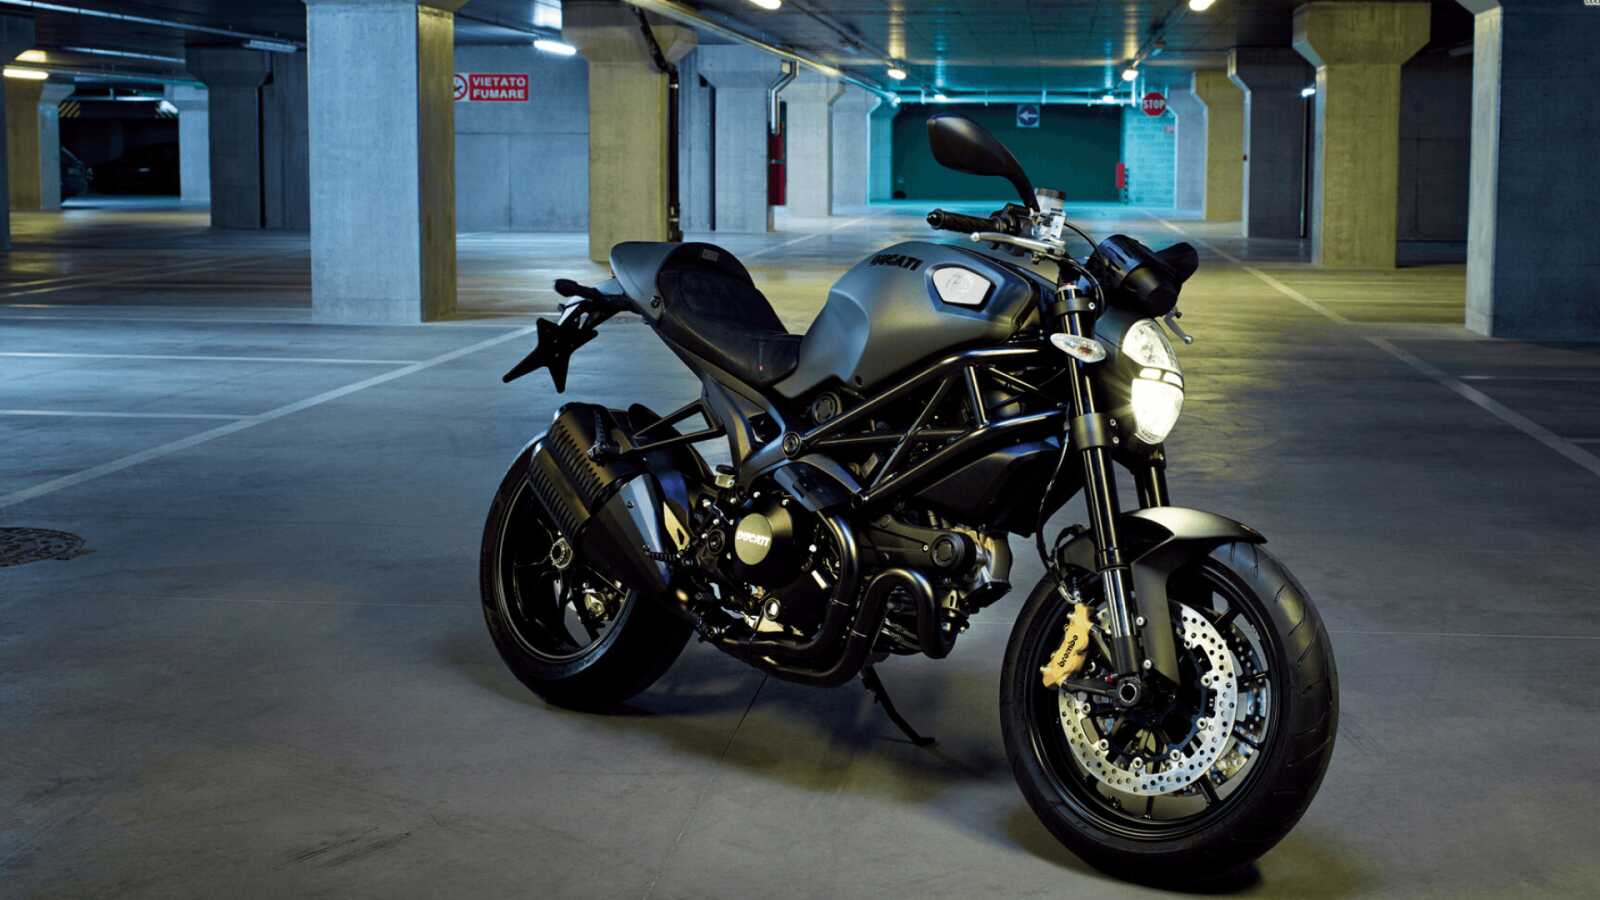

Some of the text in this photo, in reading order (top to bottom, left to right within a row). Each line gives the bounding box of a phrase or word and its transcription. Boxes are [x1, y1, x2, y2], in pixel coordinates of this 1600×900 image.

[473, 77, 526, 87] VIETATO
[473, 89, 525, 99] FUMARE
[1143, 99, 1165, 110] STOP
[870, 254, 924, 271] DUCATI
[736, 530, 770, 547] DUCATI
[1057, 634, 1079, 668] brembo
